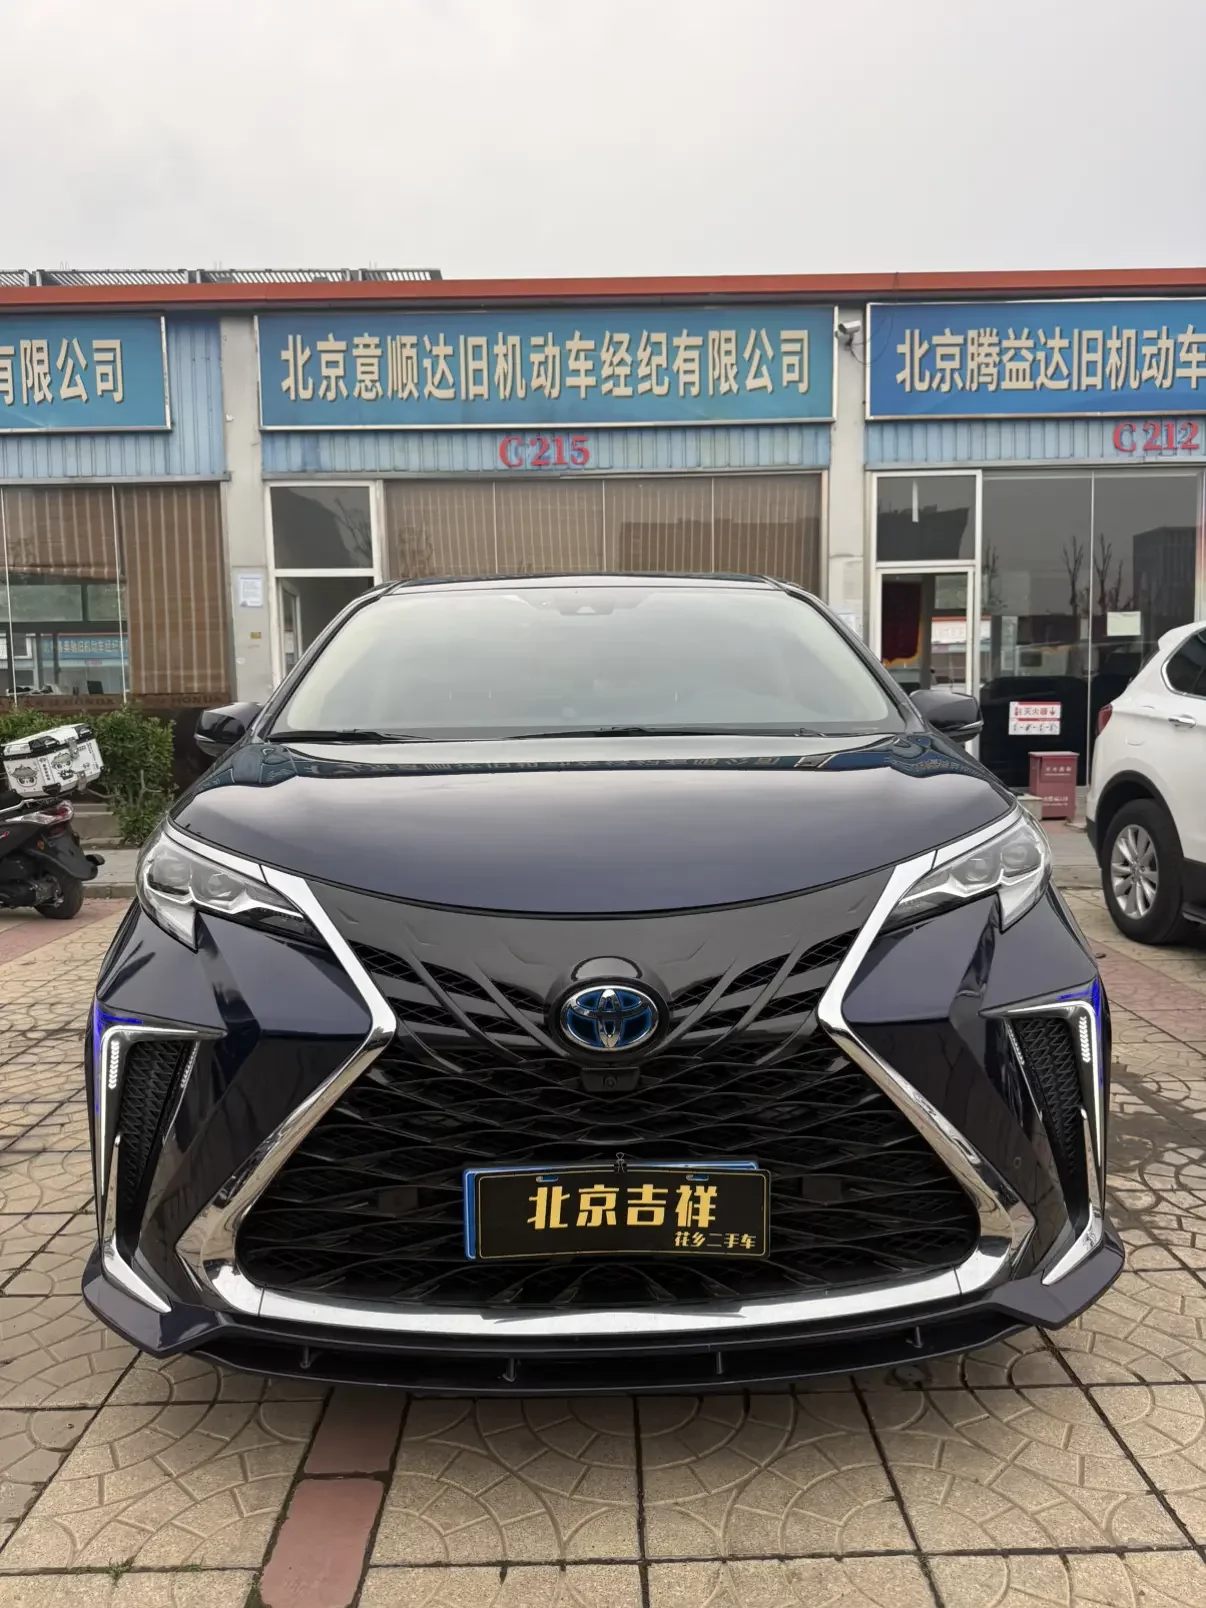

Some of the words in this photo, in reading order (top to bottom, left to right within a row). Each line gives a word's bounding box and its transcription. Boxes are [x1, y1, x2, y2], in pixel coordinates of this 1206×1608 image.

[281, 329, 810, 401] 北京意顺达旧机动车经纪有限公司
[896, 324, 1206, 391] 北京腾益达旧机动车
[527, 1184, 718, 1230] 北京吉祥
[675, 1232, 756, 1249] 花乡二手车
